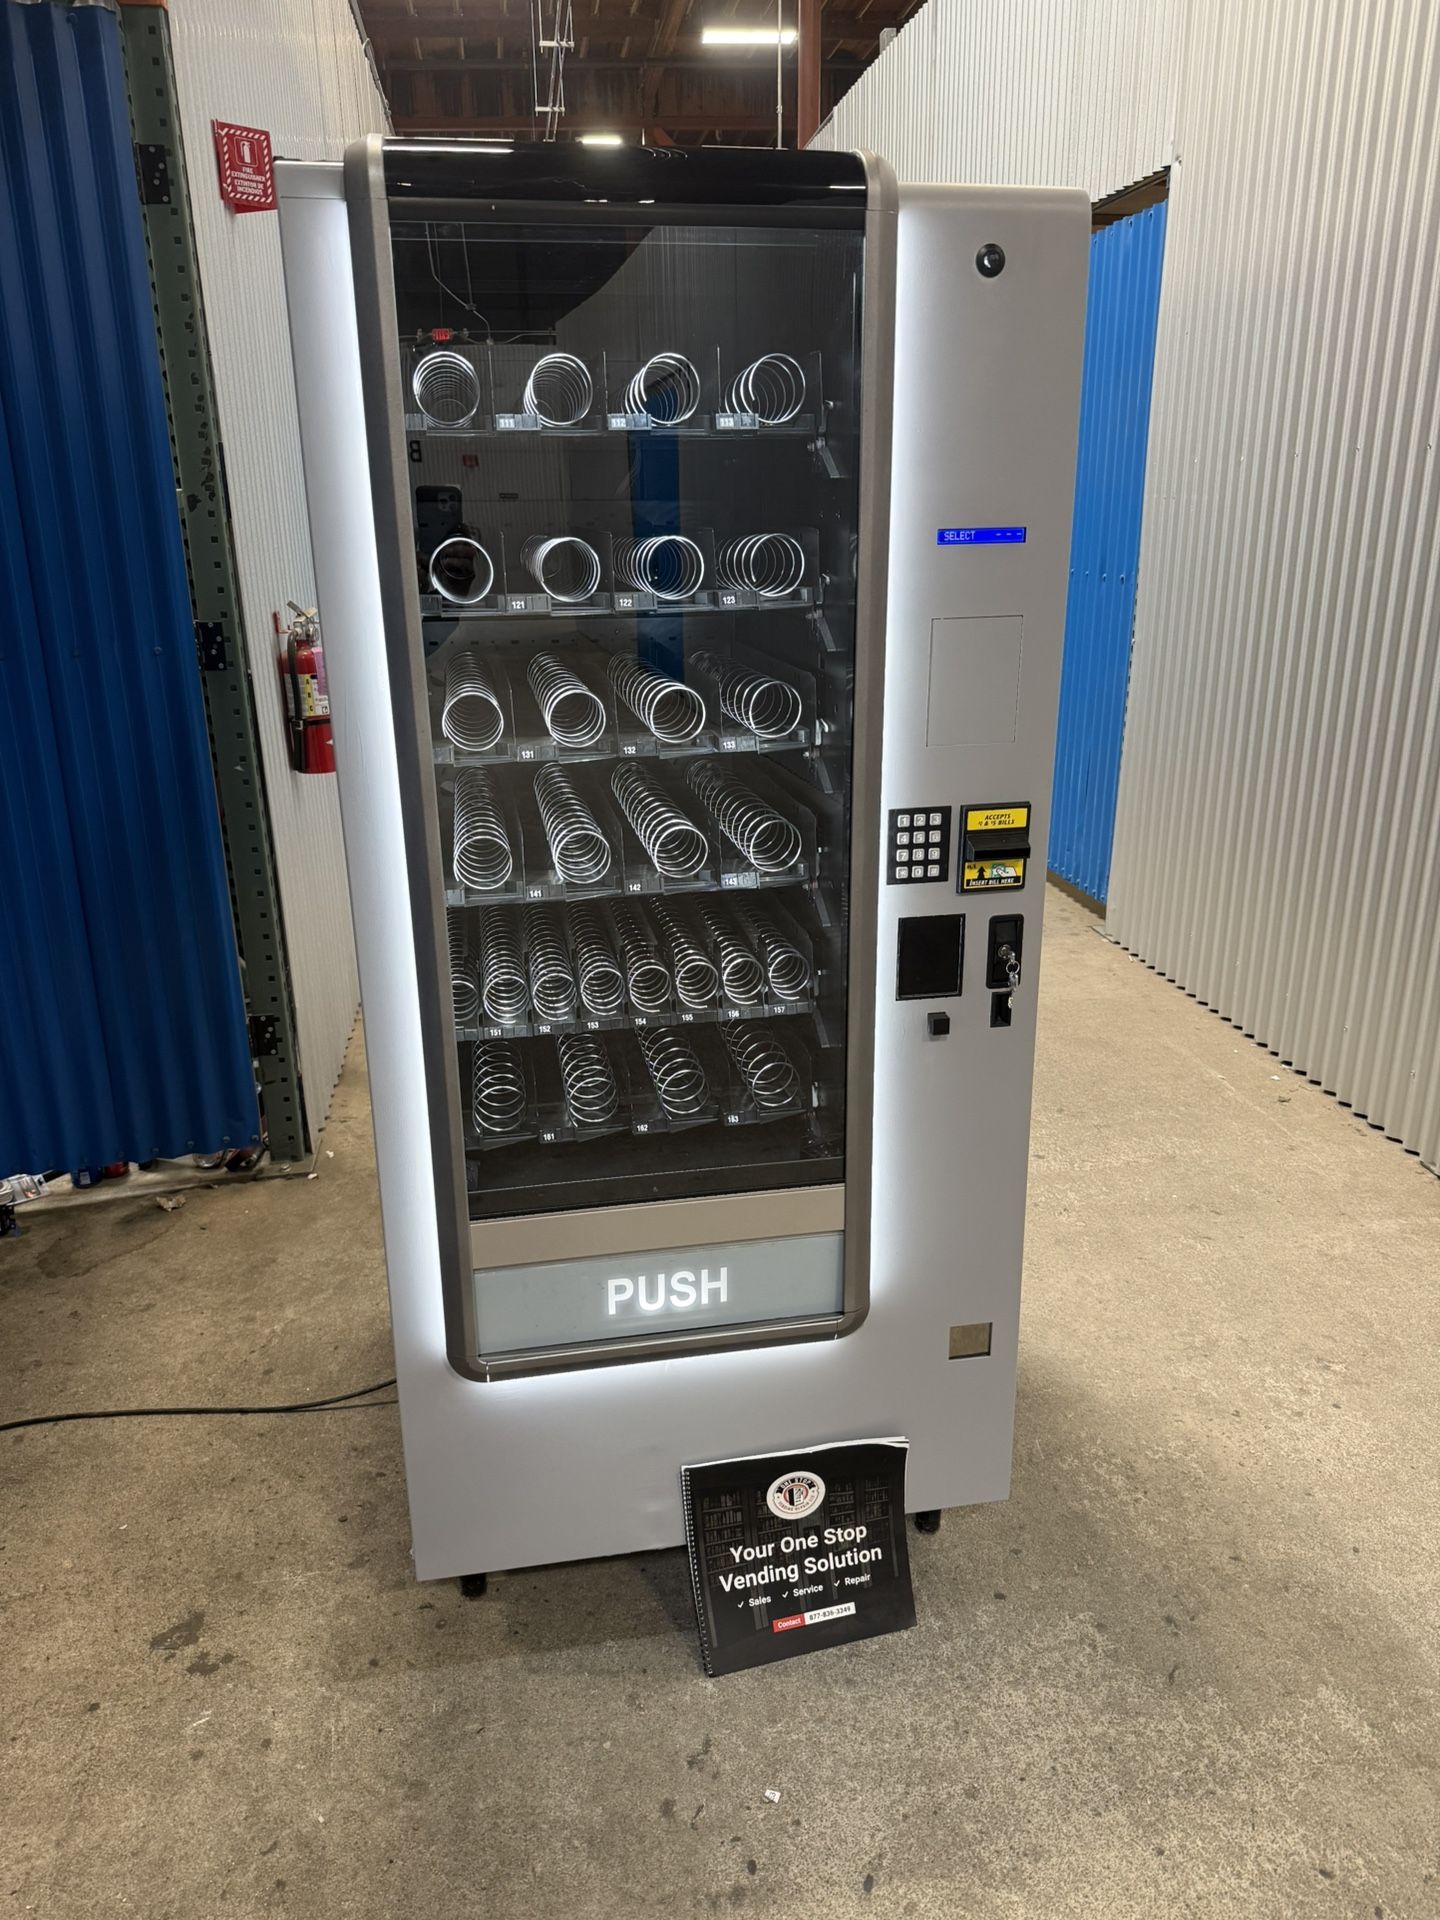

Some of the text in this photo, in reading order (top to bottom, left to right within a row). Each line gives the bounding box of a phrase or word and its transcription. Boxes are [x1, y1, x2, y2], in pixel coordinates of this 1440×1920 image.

[611, 418, 626, 428] 112
[944, 531, 975, 541] SELECT
[511, 600, 525, 609] 121
[619, 598, 632, 607] 122
[722, 596, 735, 605] 123
[723, 740, 736, 750] 133
[521, 750, 534, 759] 131
[623, 746, 636, 754] 132
[724, 877, 737, 886] 143
[629, 884, 641, 892] 142
[529, 889, 542, 898] 141
[728, 1010, 740, 1018] 156
[774, 1006, 785, 1014] 157
[634, 1017, 646, 1025] 154
[681, 1013, 694, 1021] 155
[540, 1025, 551, 1033] 152
[587, 1021, 599, 1029] 153
[490, 1028, 502, 1036] 151
[636, 1124, 648, 1132] 162
[607, 1267, 728, 1315] PUSH
[730, 1525, 867, 1564] Your One Stop
[719, 1547, 883, 1593] Vending Solution
[844, 1573, 871, 1586] Repair
[793, 1584, 824, 1597] Service
[748, 1595, 772, 1607] Sales
[777, 1618, 801, 1628] Contact
